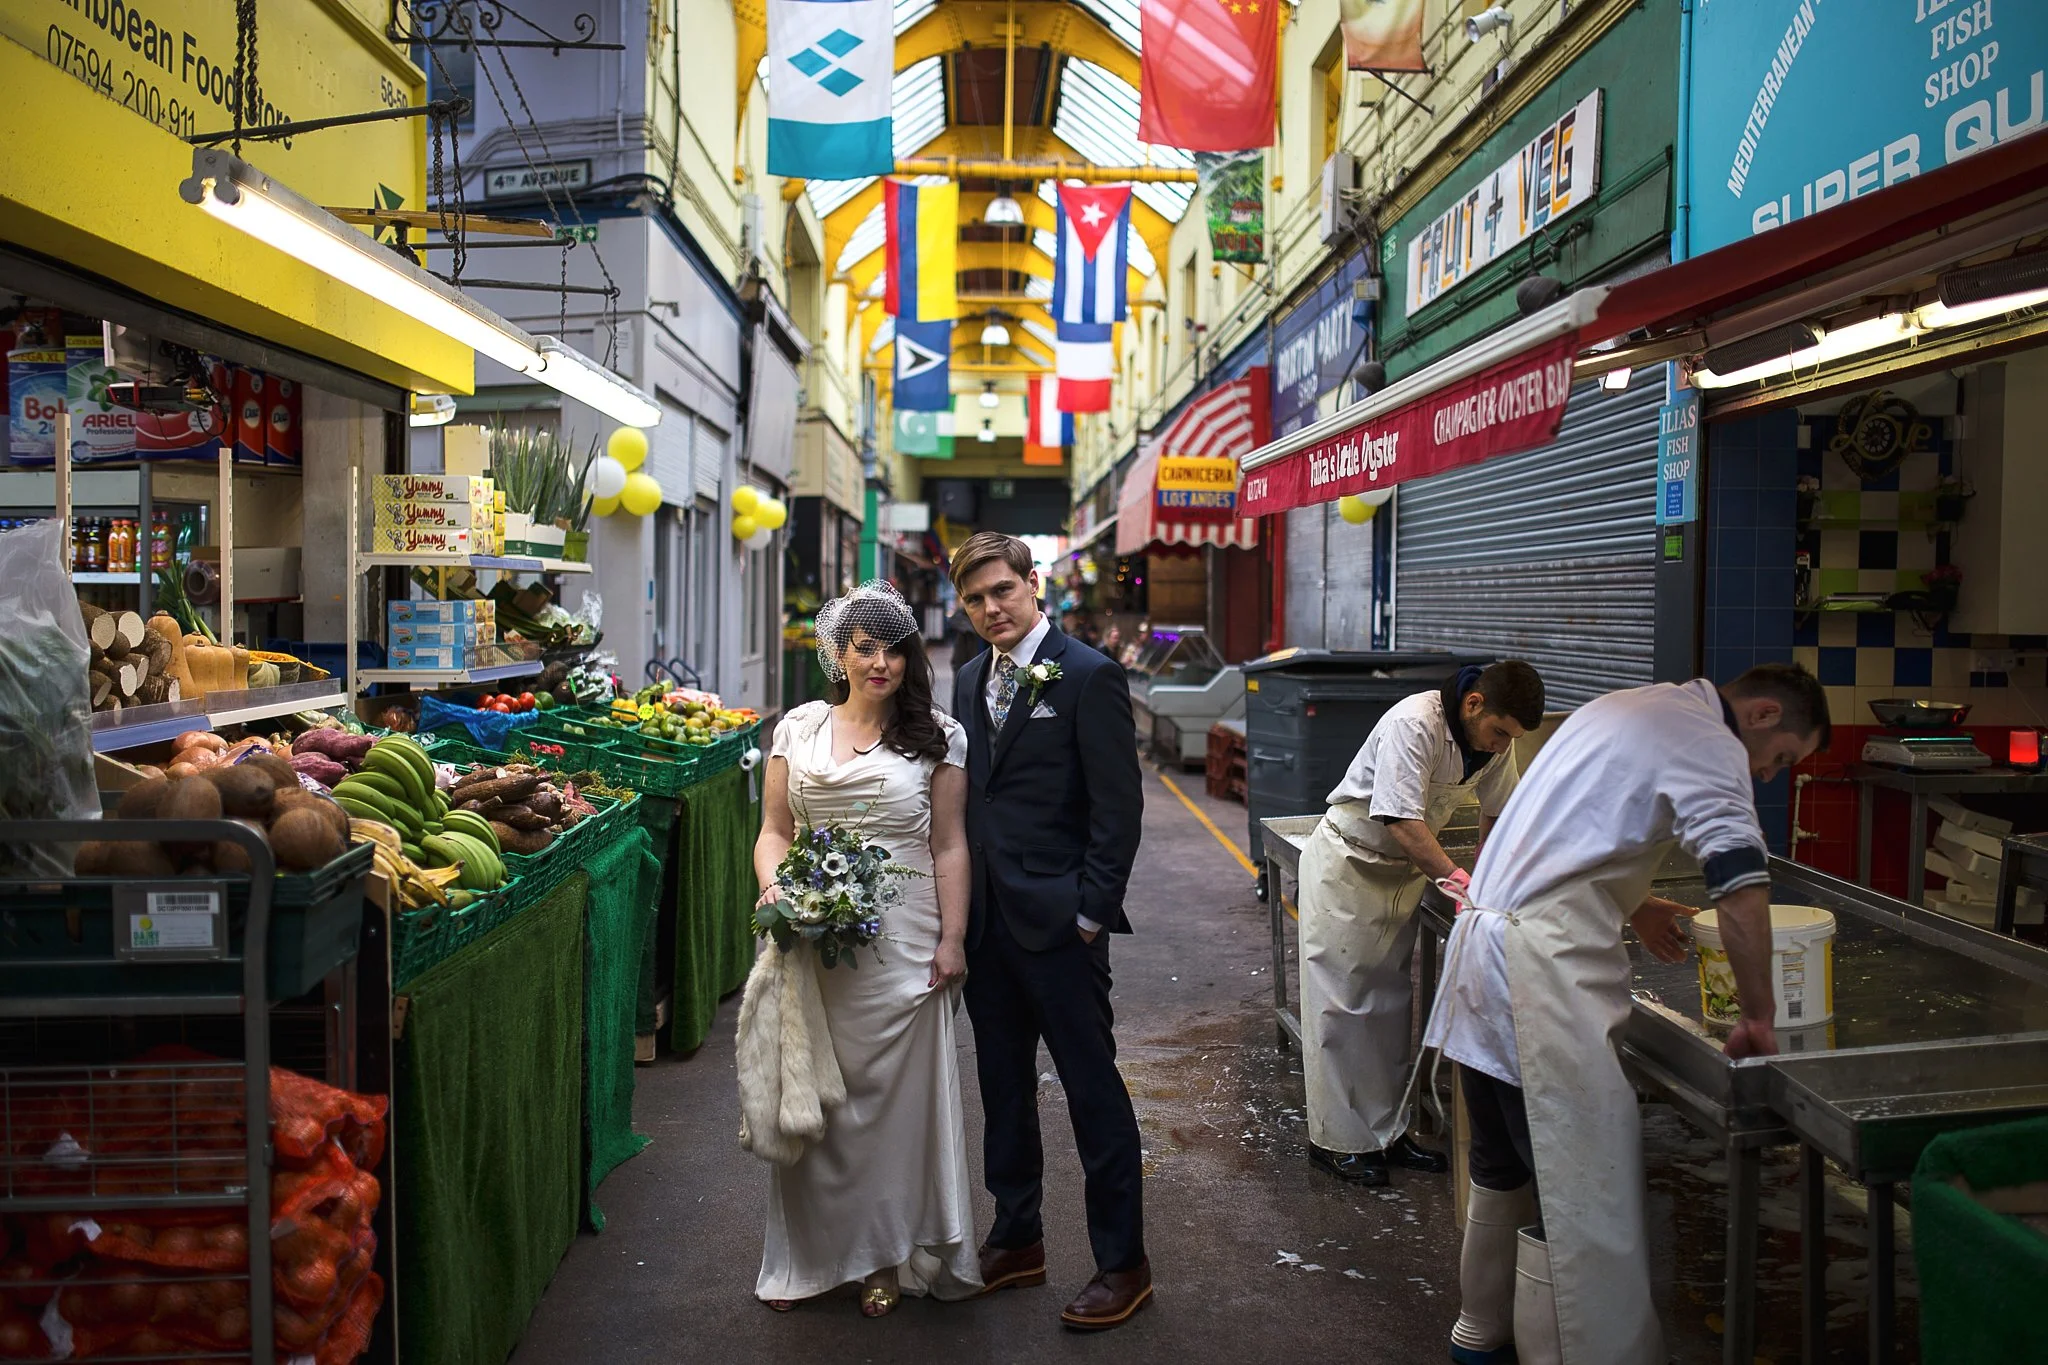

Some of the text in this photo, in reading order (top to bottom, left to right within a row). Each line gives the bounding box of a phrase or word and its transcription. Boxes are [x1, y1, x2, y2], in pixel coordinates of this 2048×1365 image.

[1931, 0, 1993, 60] FISH
[47, 24, 114, 96] 07594
[169, 98, 195, 137] 911
[182, 31, 238, 114] Food
[1925, 41, 1999, 108] SHOP
[1726, 0, 1816, 199] MEDITERRANEAN
[520, 168, 580, 188] AVENUE
[1752, 133, 1920, 235] SUPER
[1416, 188, 1480, 307] FRUIT
[1518, 109, 1577, 237] VEG
[24, 396, 68, 420] Bol
[1498, 369, 1544, 423] OYSTER
[82, 414, 136, 428] ARIEL
[1661, 404, 1696, 435] ILIAS
[1362, 430, 1399, 481] Oyster
[1666, 436, 1689, 457] FISH
[1162, 466, 1235, 483] CARNICERIA
[1663, 459, 1690, 481] SHOP
[403, 476, 444, 499] Yummy
[1162, 491, 1232, 508] LOS ANDES
[404, 503, 446, 526] Yummy
[405, 529, 447, 552] Yummy
